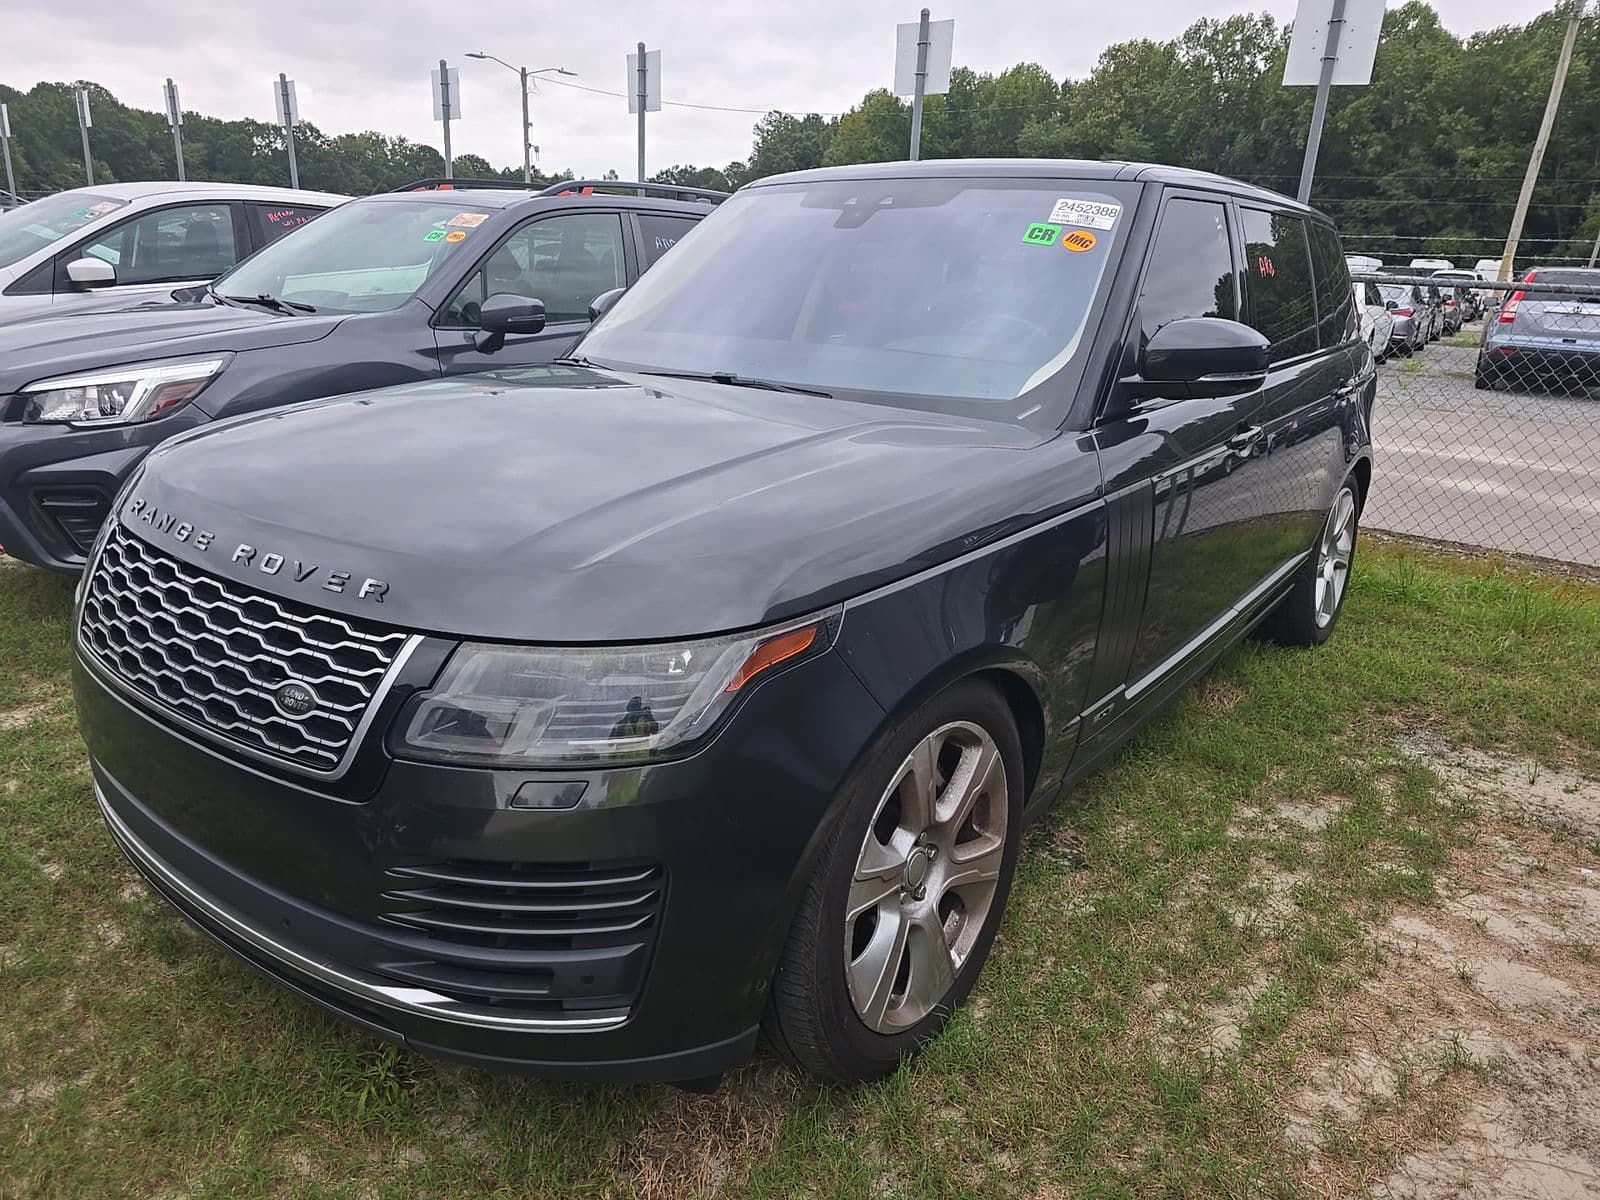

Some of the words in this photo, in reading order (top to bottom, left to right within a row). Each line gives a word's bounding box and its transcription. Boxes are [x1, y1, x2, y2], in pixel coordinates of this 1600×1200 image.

[1057, 201, 1118, 218] 2452388
[1028, 226, 1055, 241] CR
[130, 496, 216, 551] RANGE
[231, 543, 390, 603] ROVER
[285, 687, 305, 701] LAND
[284, 696, 309, 711] ROVER
